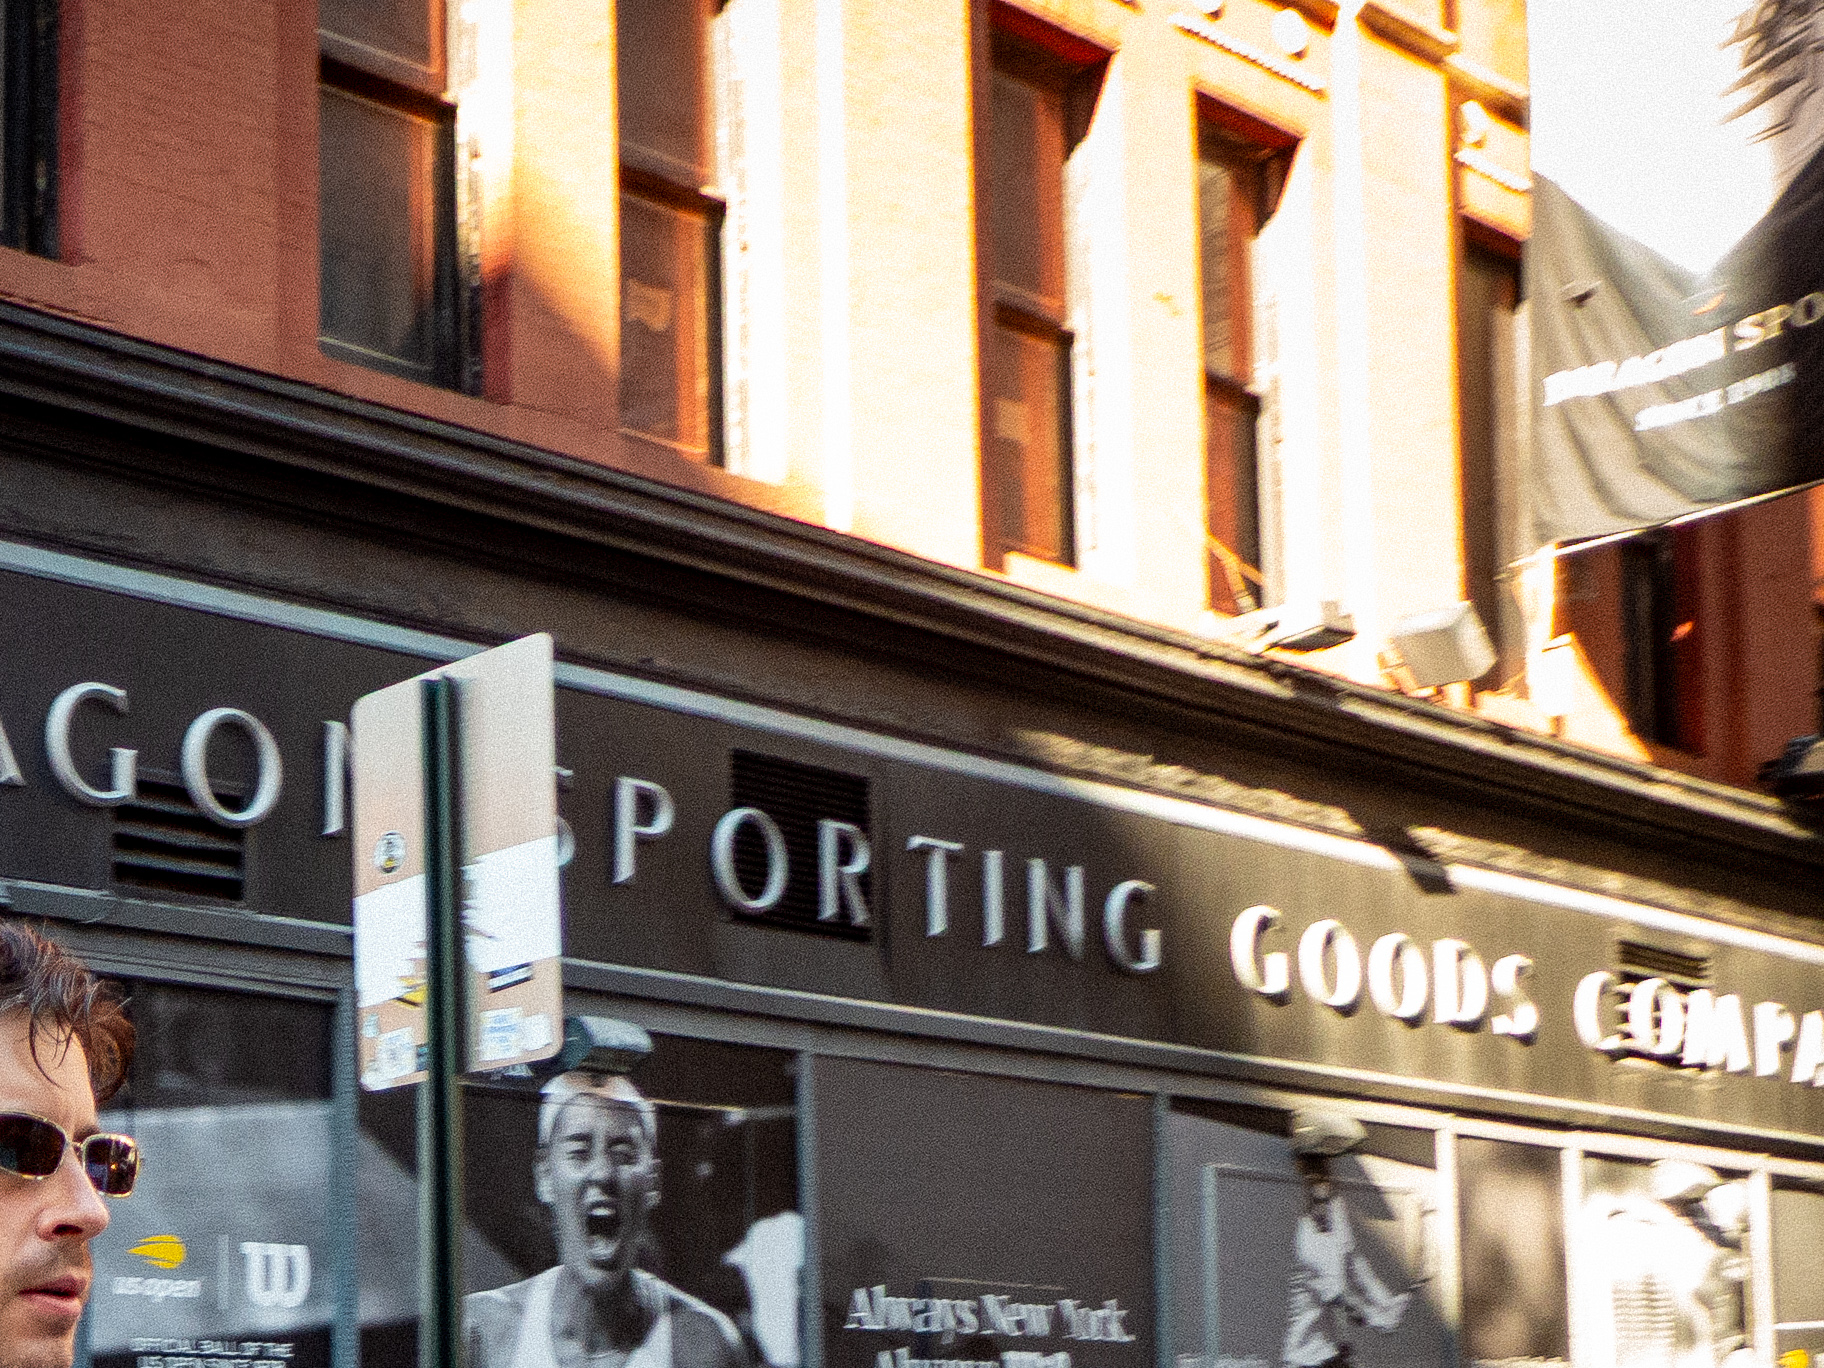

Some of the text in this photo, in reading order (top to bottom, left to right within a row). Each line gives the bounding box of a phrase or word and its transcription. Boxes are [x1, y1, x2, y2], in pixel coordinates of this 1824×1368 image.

[556, 763, 1163, 974] PORTING
[1229, 903, 1539, 1041] GOODS
[843, 1284, 978, 1344] Always
[979, 1294, 1056, 1337] New
